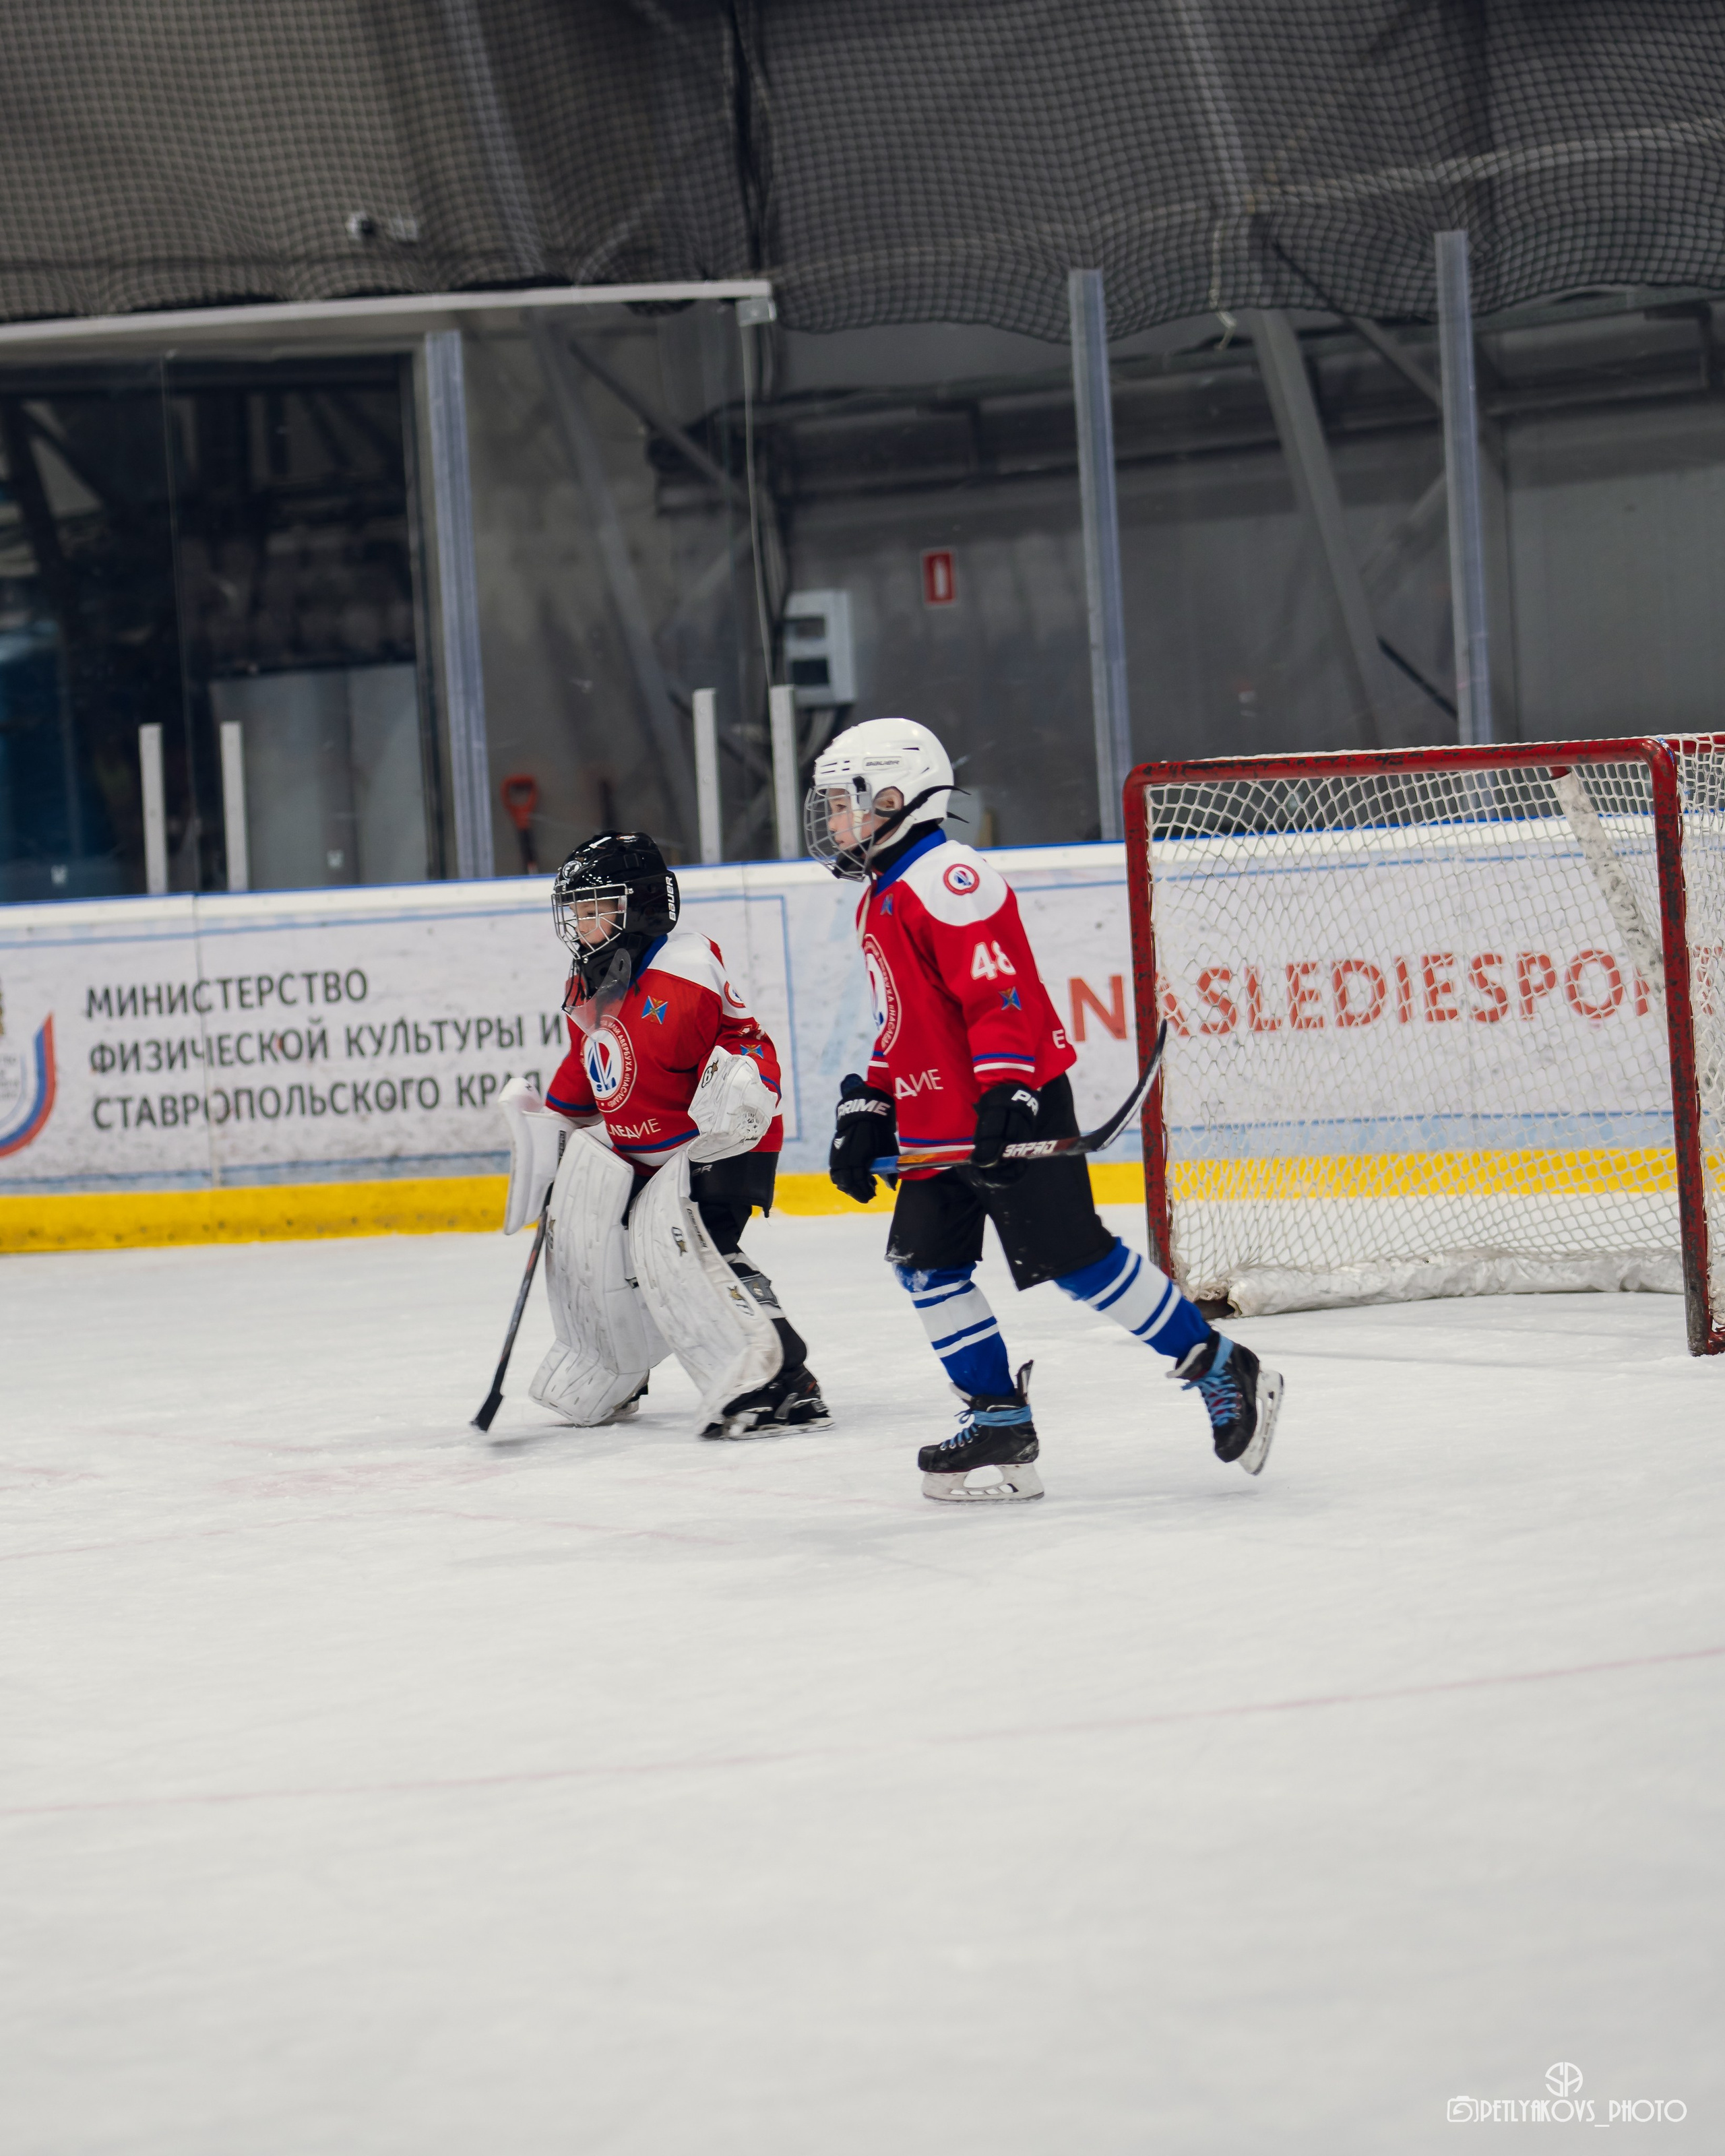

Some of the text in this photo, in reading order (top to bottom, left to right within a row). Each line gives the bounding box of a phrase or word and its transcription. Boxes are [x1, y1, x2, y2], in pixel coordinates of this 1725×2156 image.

[665, 876, 677, 922] BAUER
[86, 968, 369, 1019] МИНИСТЕРСТВО
[90, 1013, 563, 1074] ФИЗИЧЕСКОЙ КУЛЬТУРЫ И
[92, 1076, 440, 1131] СТАВРОПОЛЬСКОГО
[608, 1118, 662, 1139] ЛЕДИЕ
